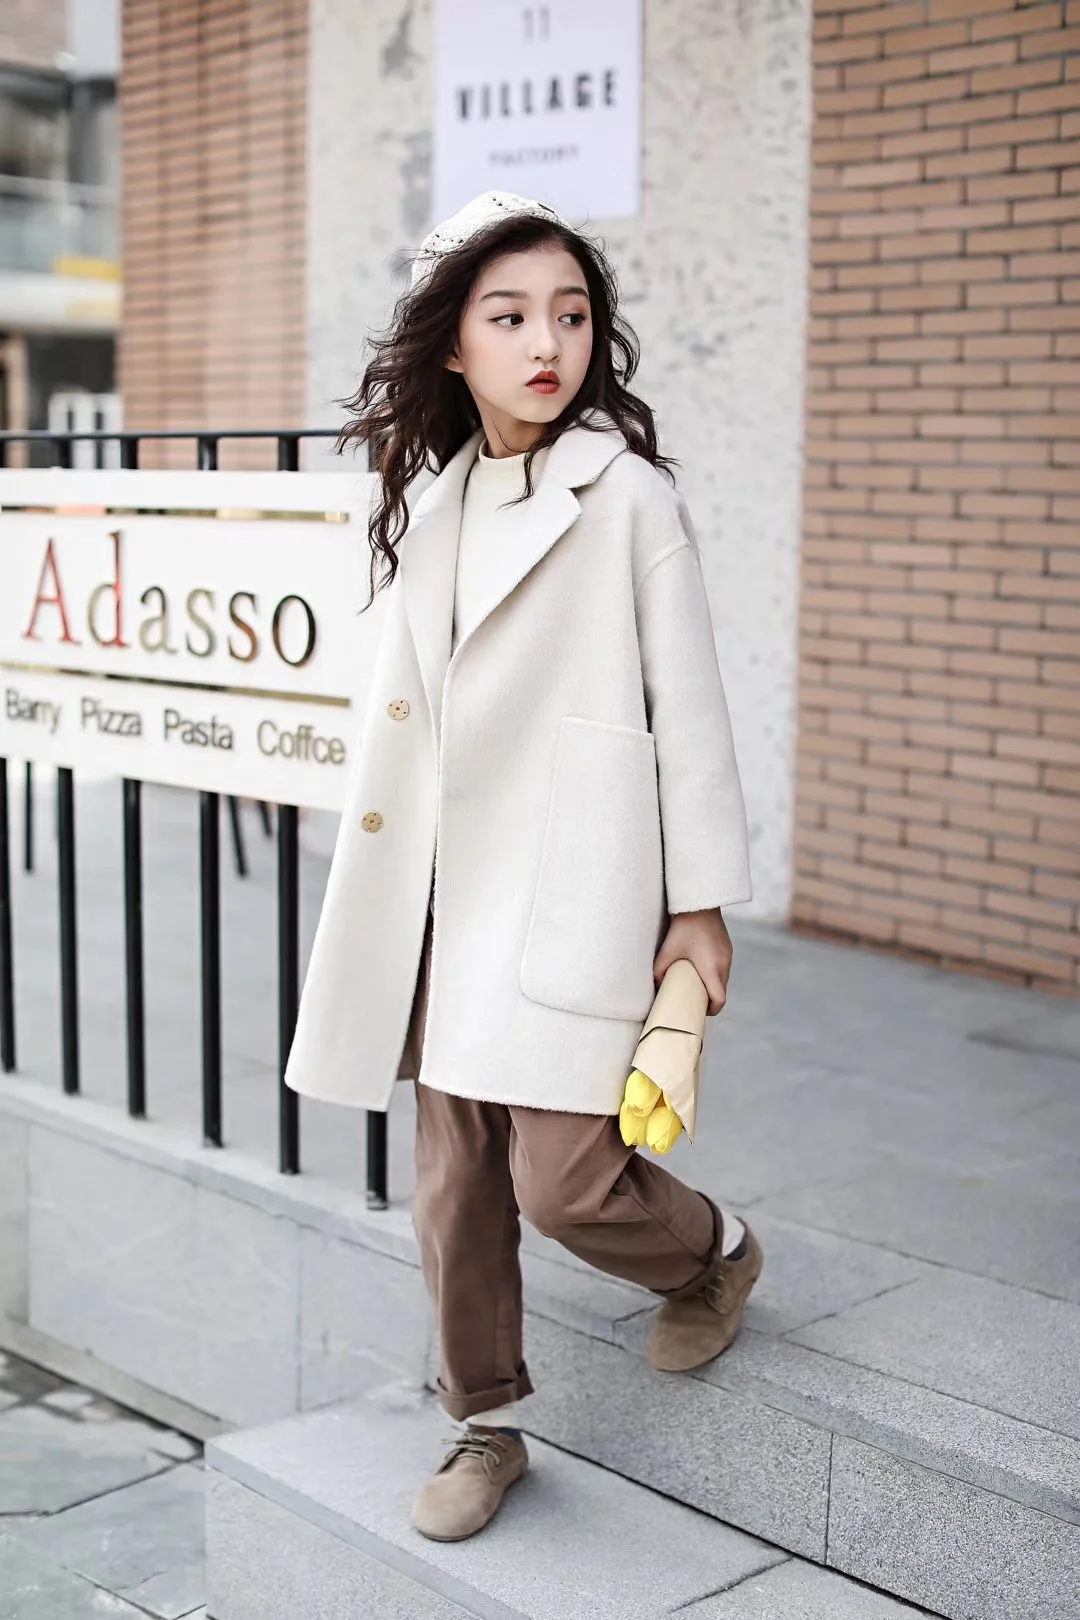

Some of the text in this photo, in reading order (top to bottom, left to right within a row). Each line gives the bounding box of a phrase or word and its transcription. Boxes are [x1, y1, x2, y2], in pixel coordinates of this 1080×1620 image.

[456, 68, 616, 121] VILLAGE
[23, 529, 318, 667] Adasso
[6, 688, 61, 734] Barry
[81, 697, 142, 736] Pizza
[164, 708, 234, 750] Pasta
